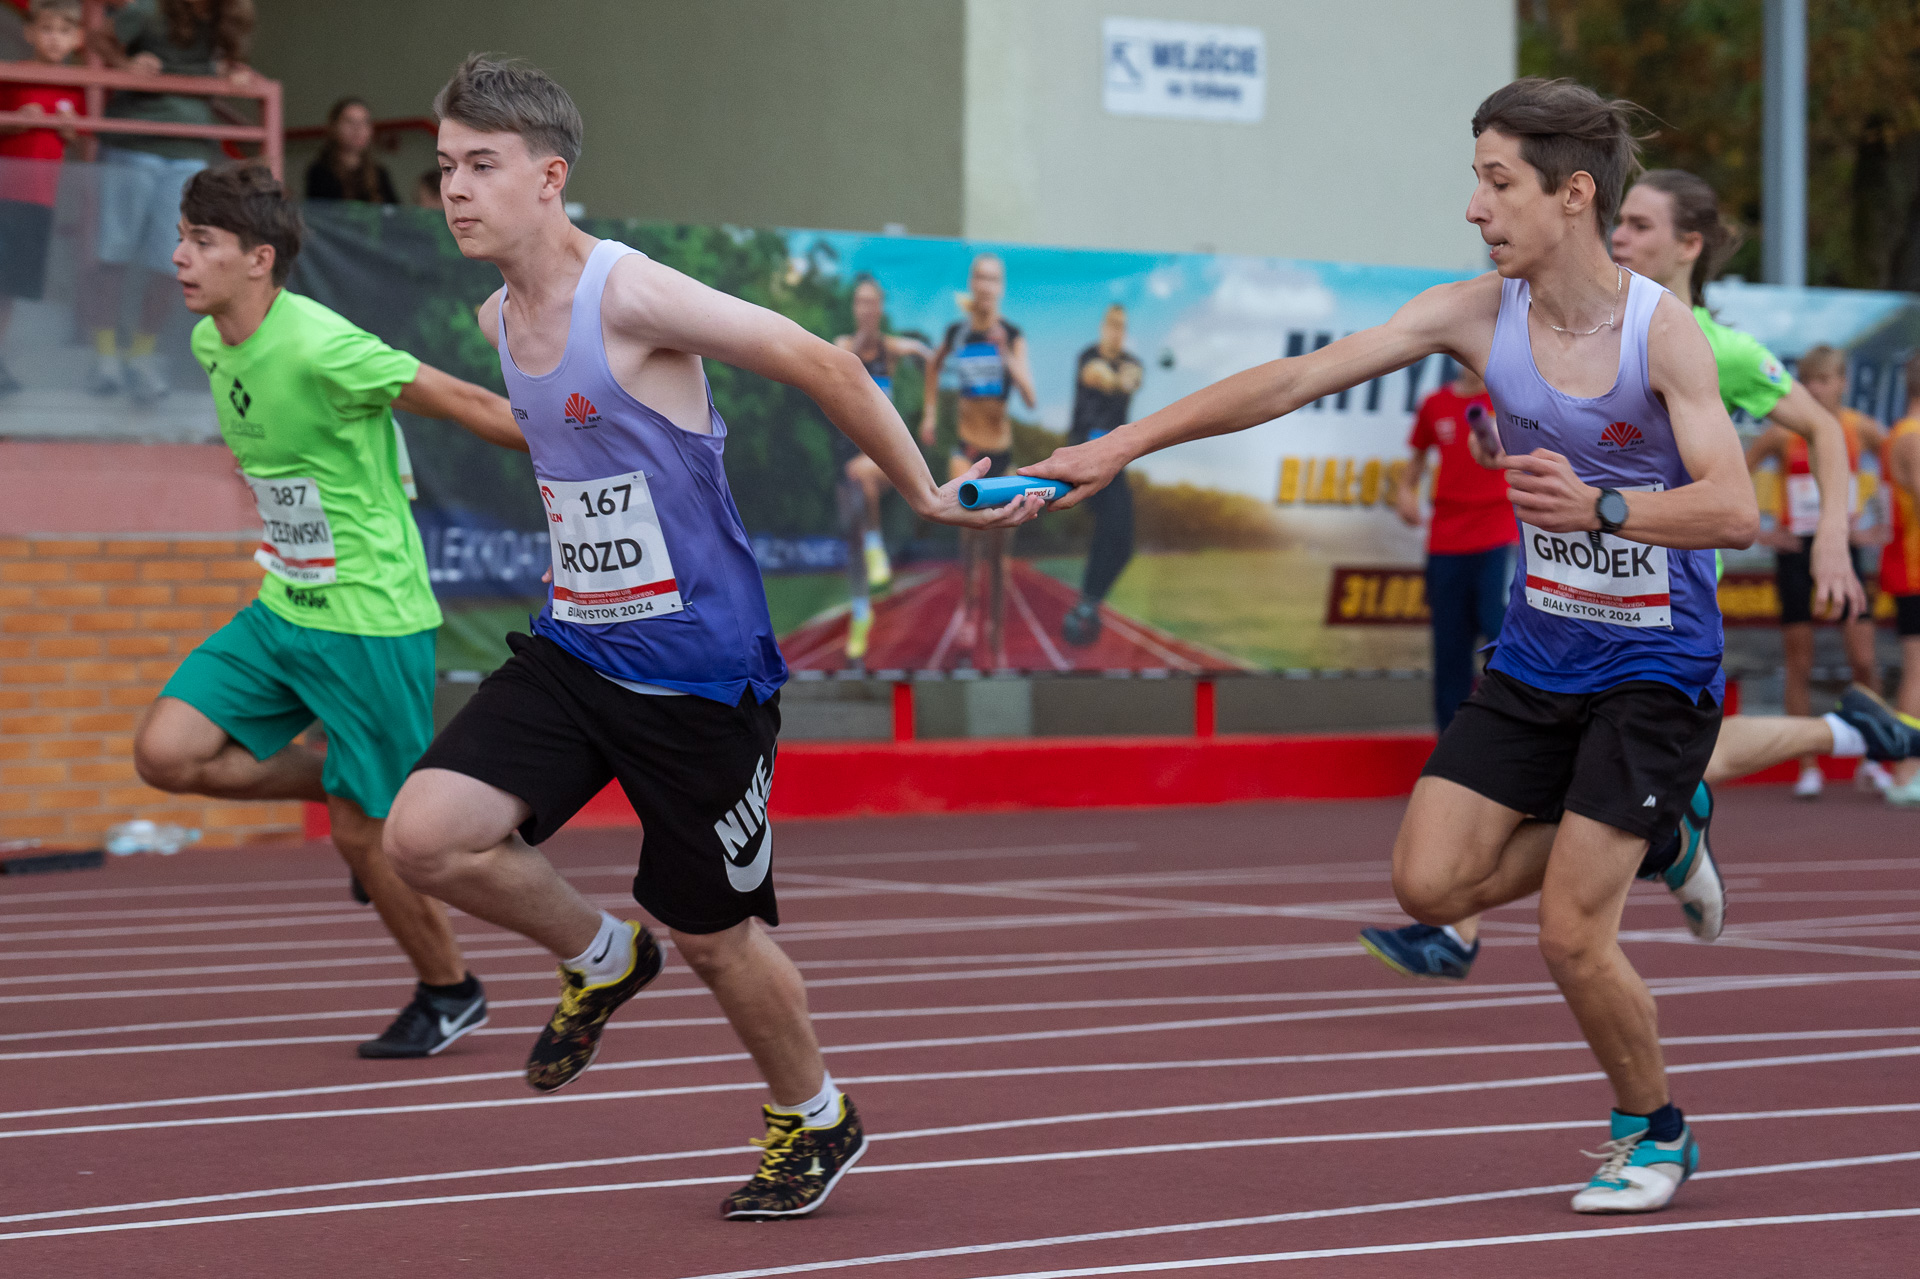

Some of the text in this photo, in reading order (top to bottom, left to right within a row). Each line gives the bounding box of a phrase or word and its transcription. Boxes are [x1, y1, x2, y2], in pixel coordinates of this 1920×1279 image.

[270, 485, 307, 506] 387
[580, 483, 632, 518] 167
[1533, 533, 1656, 578] GRODEK
[620, 601, 654, 617] 2024
[1542, 597, 1641, 623] BIAŁYSTOK 2024
[714, 754, 767, 861] NIKE
